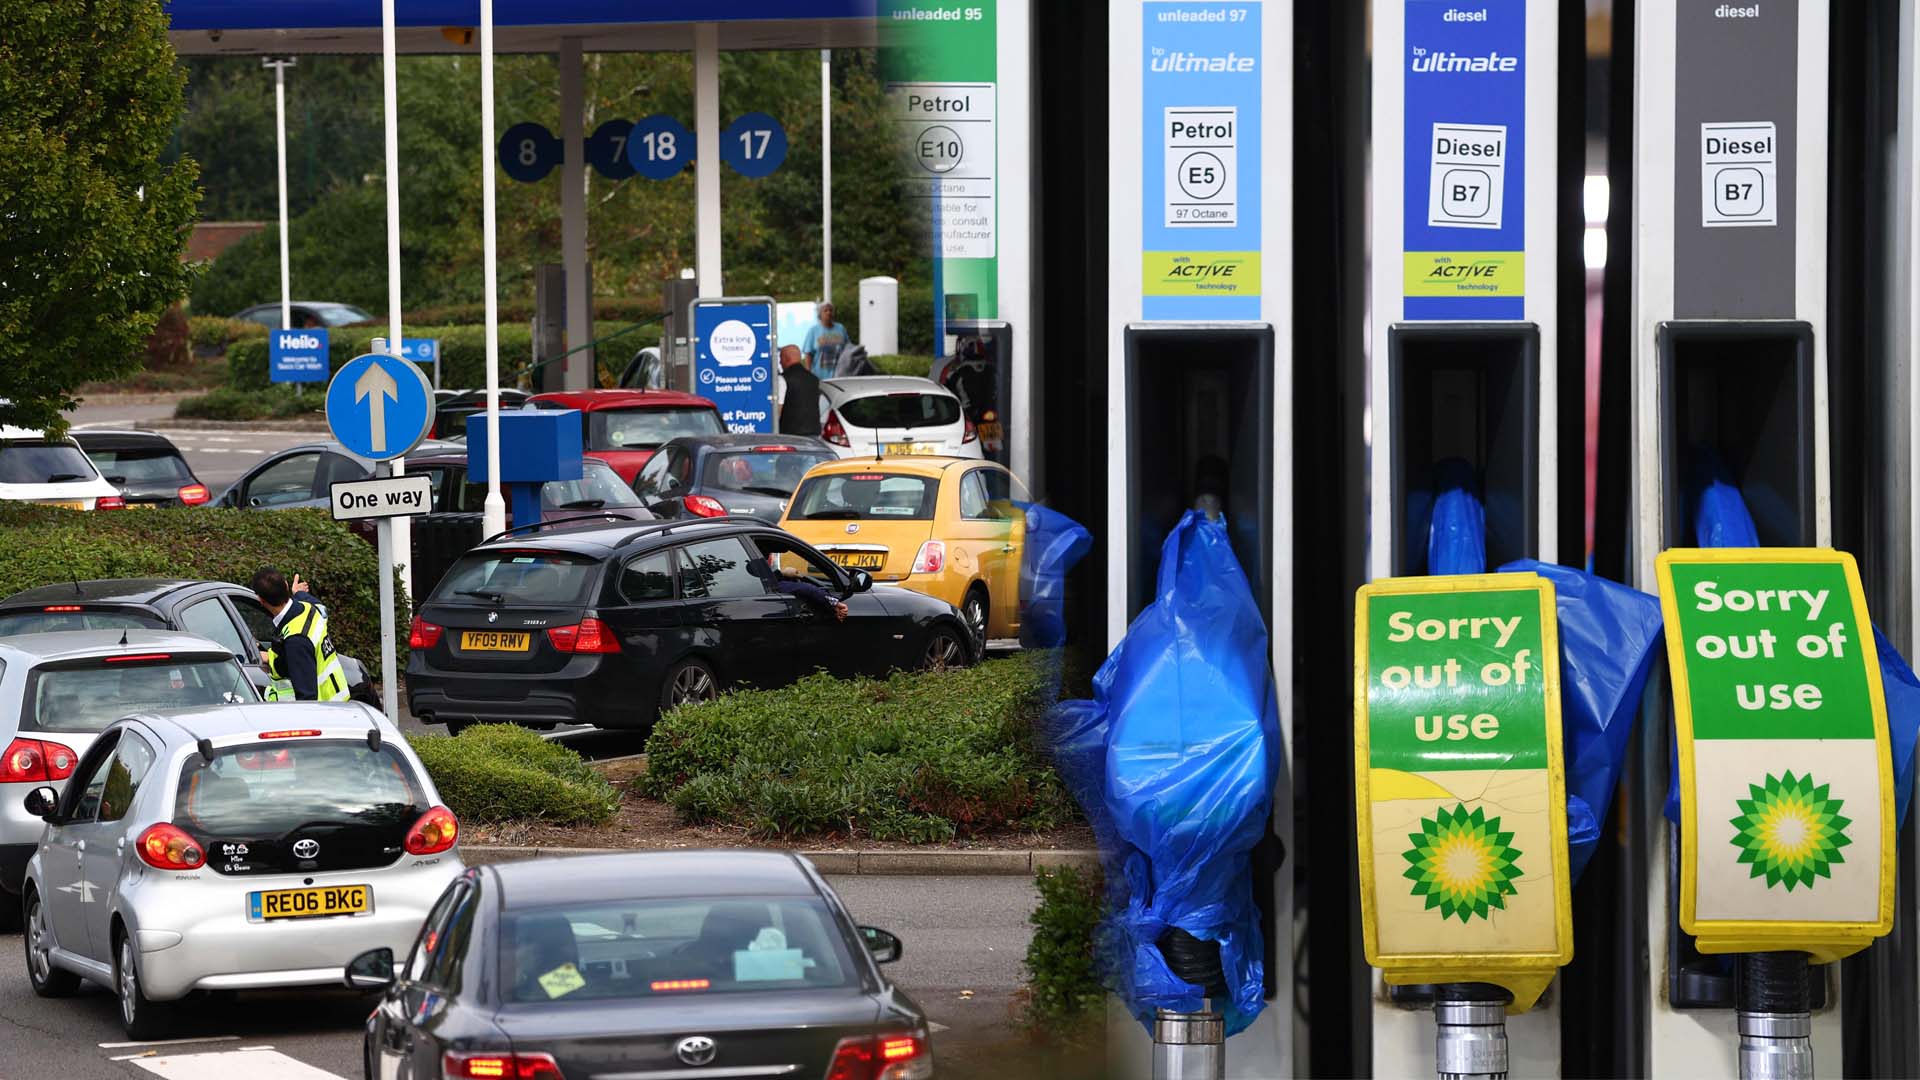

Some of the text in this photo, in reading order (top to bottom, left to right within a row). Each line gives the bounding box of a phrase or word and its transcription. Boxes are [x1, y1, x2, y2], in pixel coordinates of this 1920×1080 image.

[892, 8, 983, 20] unleaded 95
[1158, 9, 1247, 22] unleaded 97
[1443, 9, 1488, 21] diesel
[1715, 5, 1760, 18] diesel
[1412, 46, 1427, 57] bp
[1151, 52, 1255, 72] ultimate
[1412, 52, 1518, 72] ultimate
[908, 95, 970, 112] Petrol
[1171, 121, 1232, 138] Petrol
[519, 139, 537, 166] 8
[610, 136, 626, 163] 7
[643, 131, 677, 161] 18
[739, 130, 772, 160] 17
[921, 141, 959, 158] E10
[1437, 138, 1501, 157] Diesel
[1706, 137, 1772, 155] Diesel
[1189, 167, 1215, 184] E5
[1453, 185, 1480, 202] B7
[1725, 184, 1753, 201] B7
[951, 216, 989, 226] consult
[1176, 208, 1228, 219] 97 Octane
[1433, 256, 1452, 265] with
[1167, 265, 1237, 277] ACTIVE
[1429, 265, 1499, 277] ACTIVE
[1195, 283, 1238, 291] technology
[1456, 284, 1499, 292] technology
[715, 384, 752, 392] both sides
[735, 410, 766, 423] Pump
[727, 423, 756, 433] Kiosk
[339, 490, 423, 509] One way
[853, 553, 879, 567] JKN
[1691, 581, 1830, 620] Sorry
[1387, 611, 1523, 649] Sorry
[467, 633, 525, 648] YF09 RMV
[1695, 622, 1848, 659] out of
[1380, 649, 1532, 689] out of
[1735, 684, 1823, 710] use
[1415, 713, 1500, 742] use
[265, 889, 364, 914] RE06 BKG
